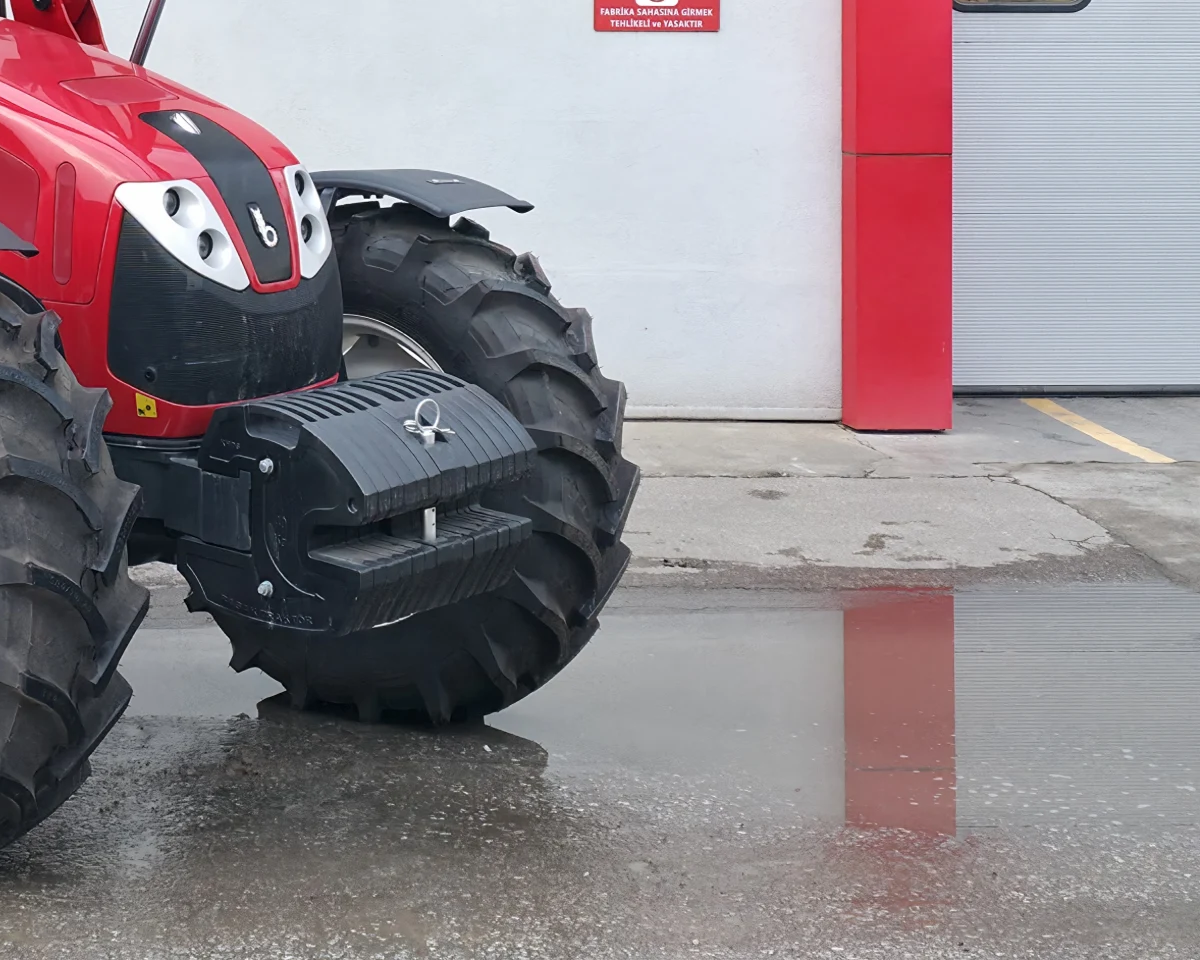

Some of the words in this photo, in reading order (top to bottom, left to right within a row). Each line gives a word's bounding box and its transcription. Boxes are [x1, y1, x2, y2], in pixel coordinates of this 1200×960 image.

[600, 7, 635, 16] FABRİKA
[637, 8, 679, 16] SAHASINA
[681, 8, 713, 17] GİRMEK
[610, 18, 651, 28] TEHLİKELİ
[664, 20, 703, 28] YASAKTIR
